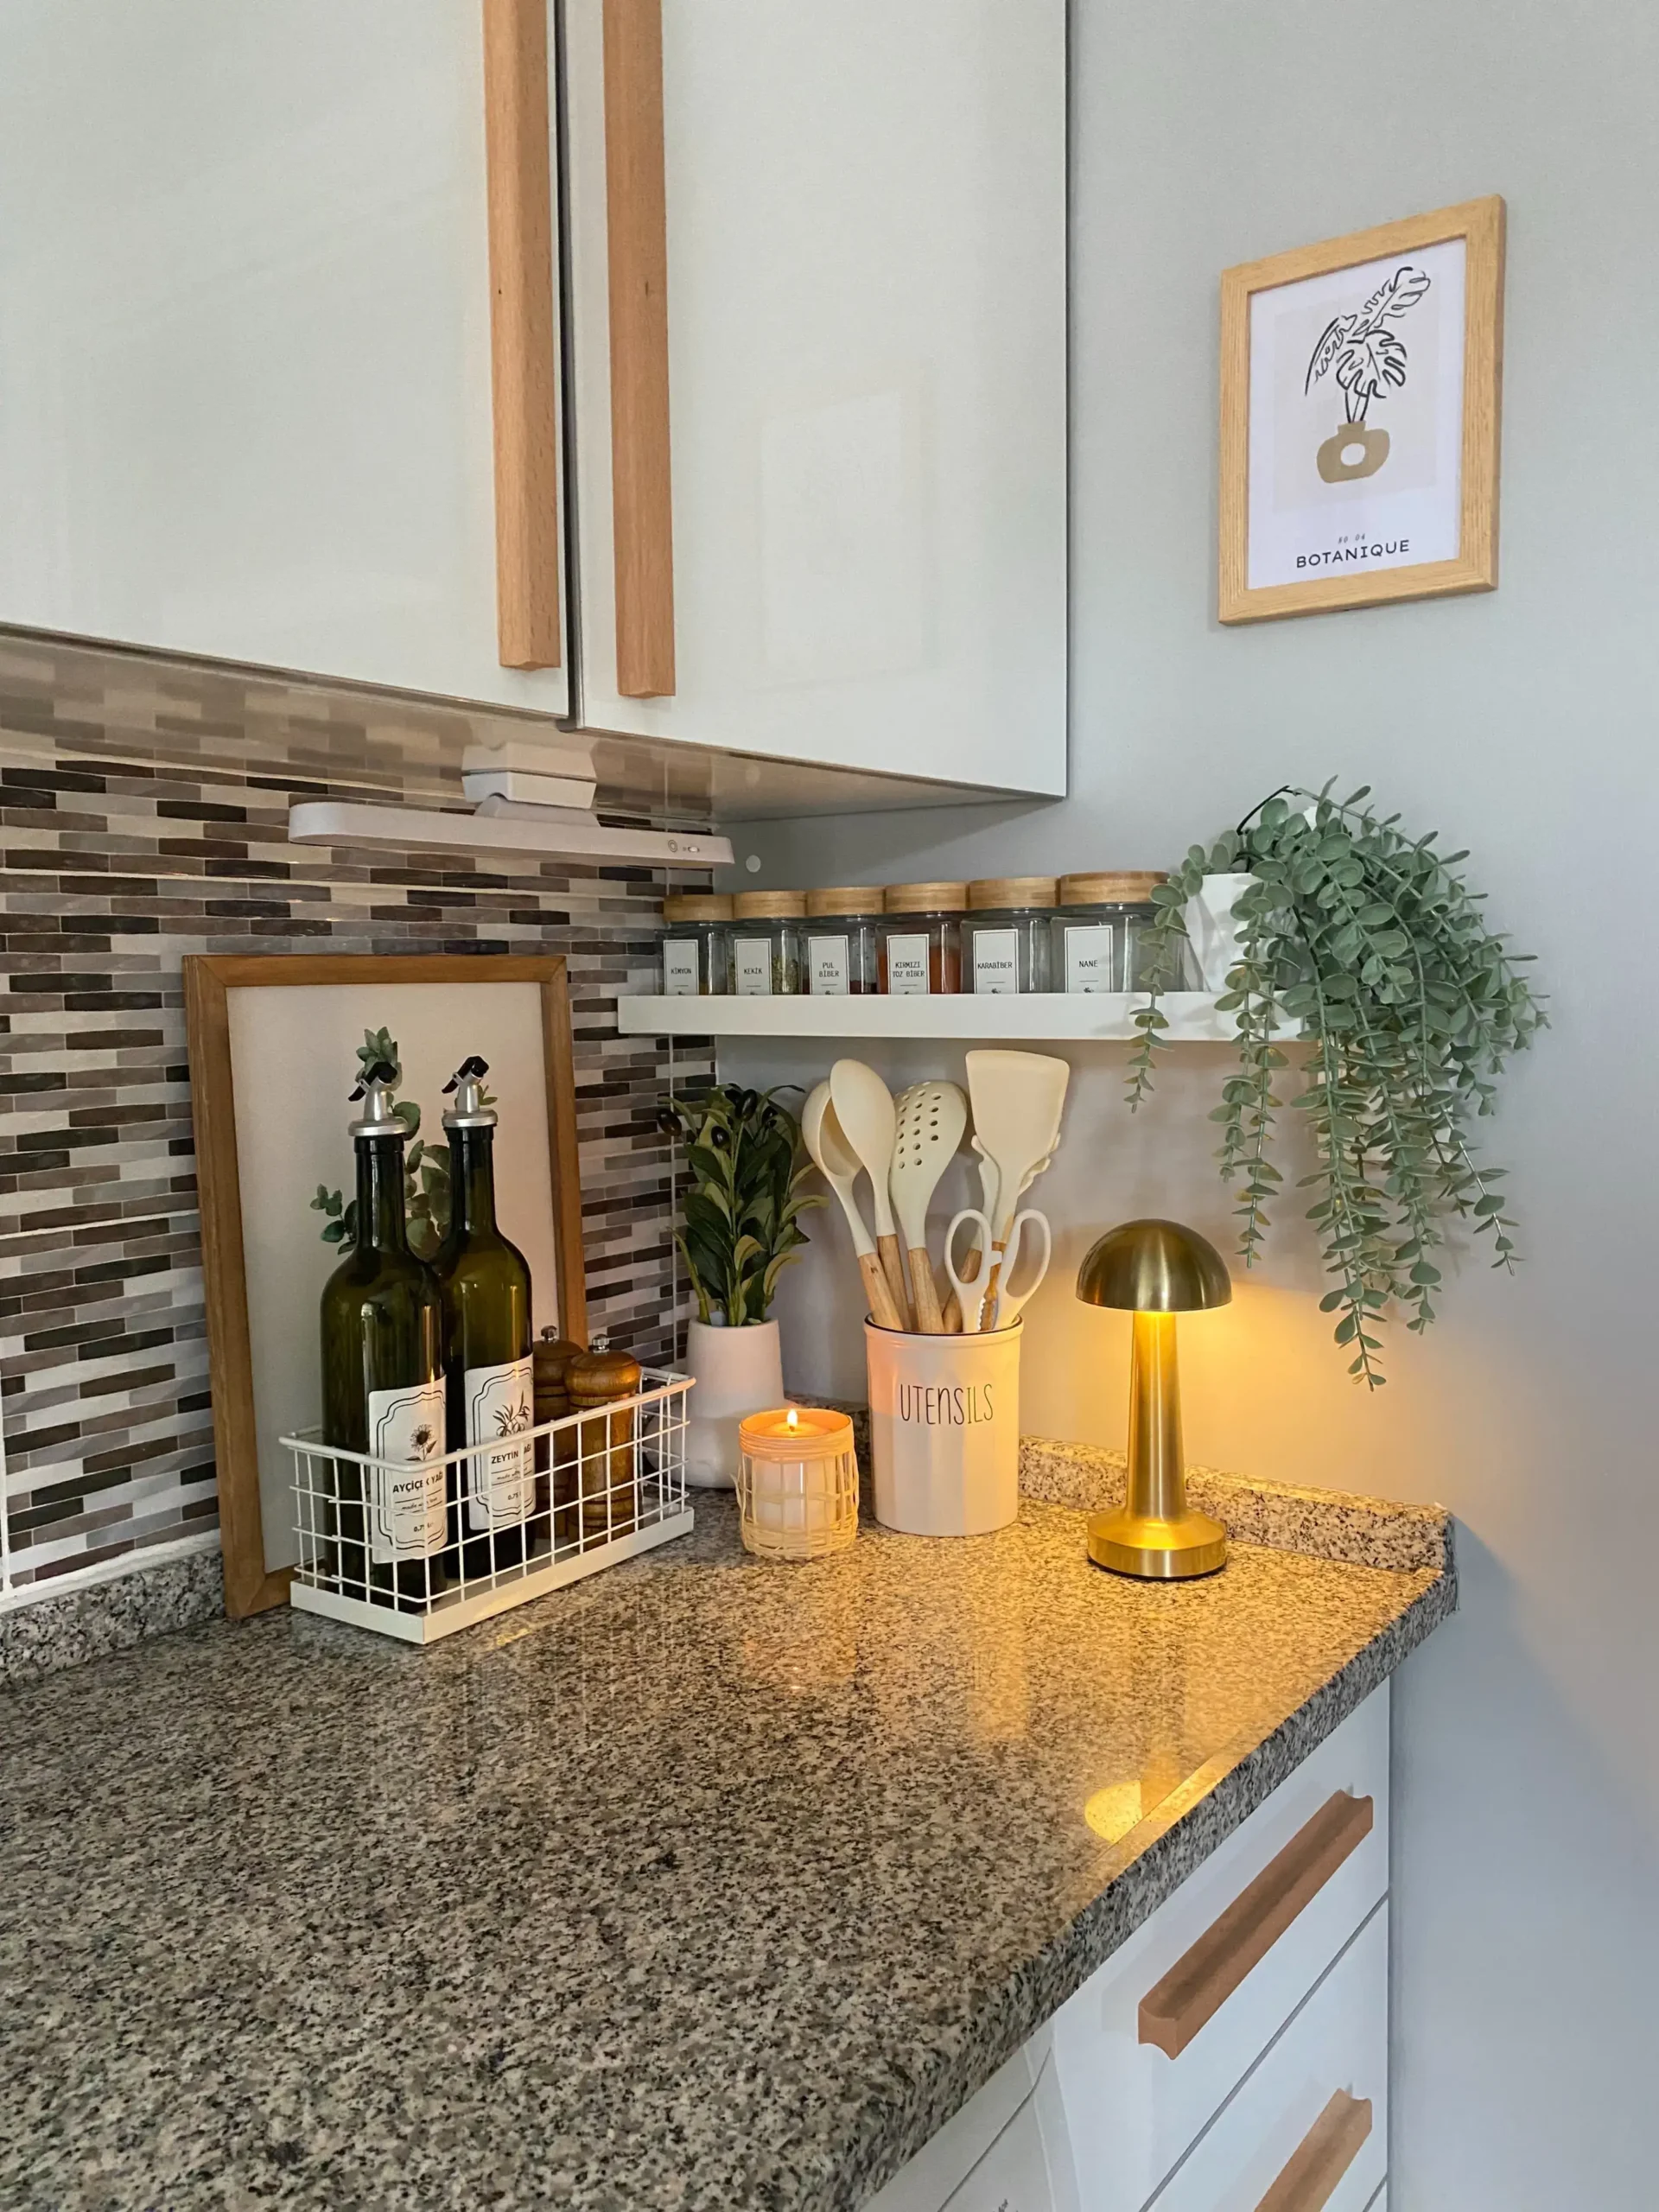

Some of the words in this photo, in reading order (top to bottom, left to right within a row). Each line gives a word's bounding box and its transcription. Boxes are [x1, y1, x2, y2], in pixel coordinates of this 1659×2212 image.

[1296, 539, 1410, 569] BOTANIQUE
[1078, 959, 1098, 968] NANE
[743, 966, 763, 975] KEKİK
[491, 1450, 518, 1465] ZEYTİN
